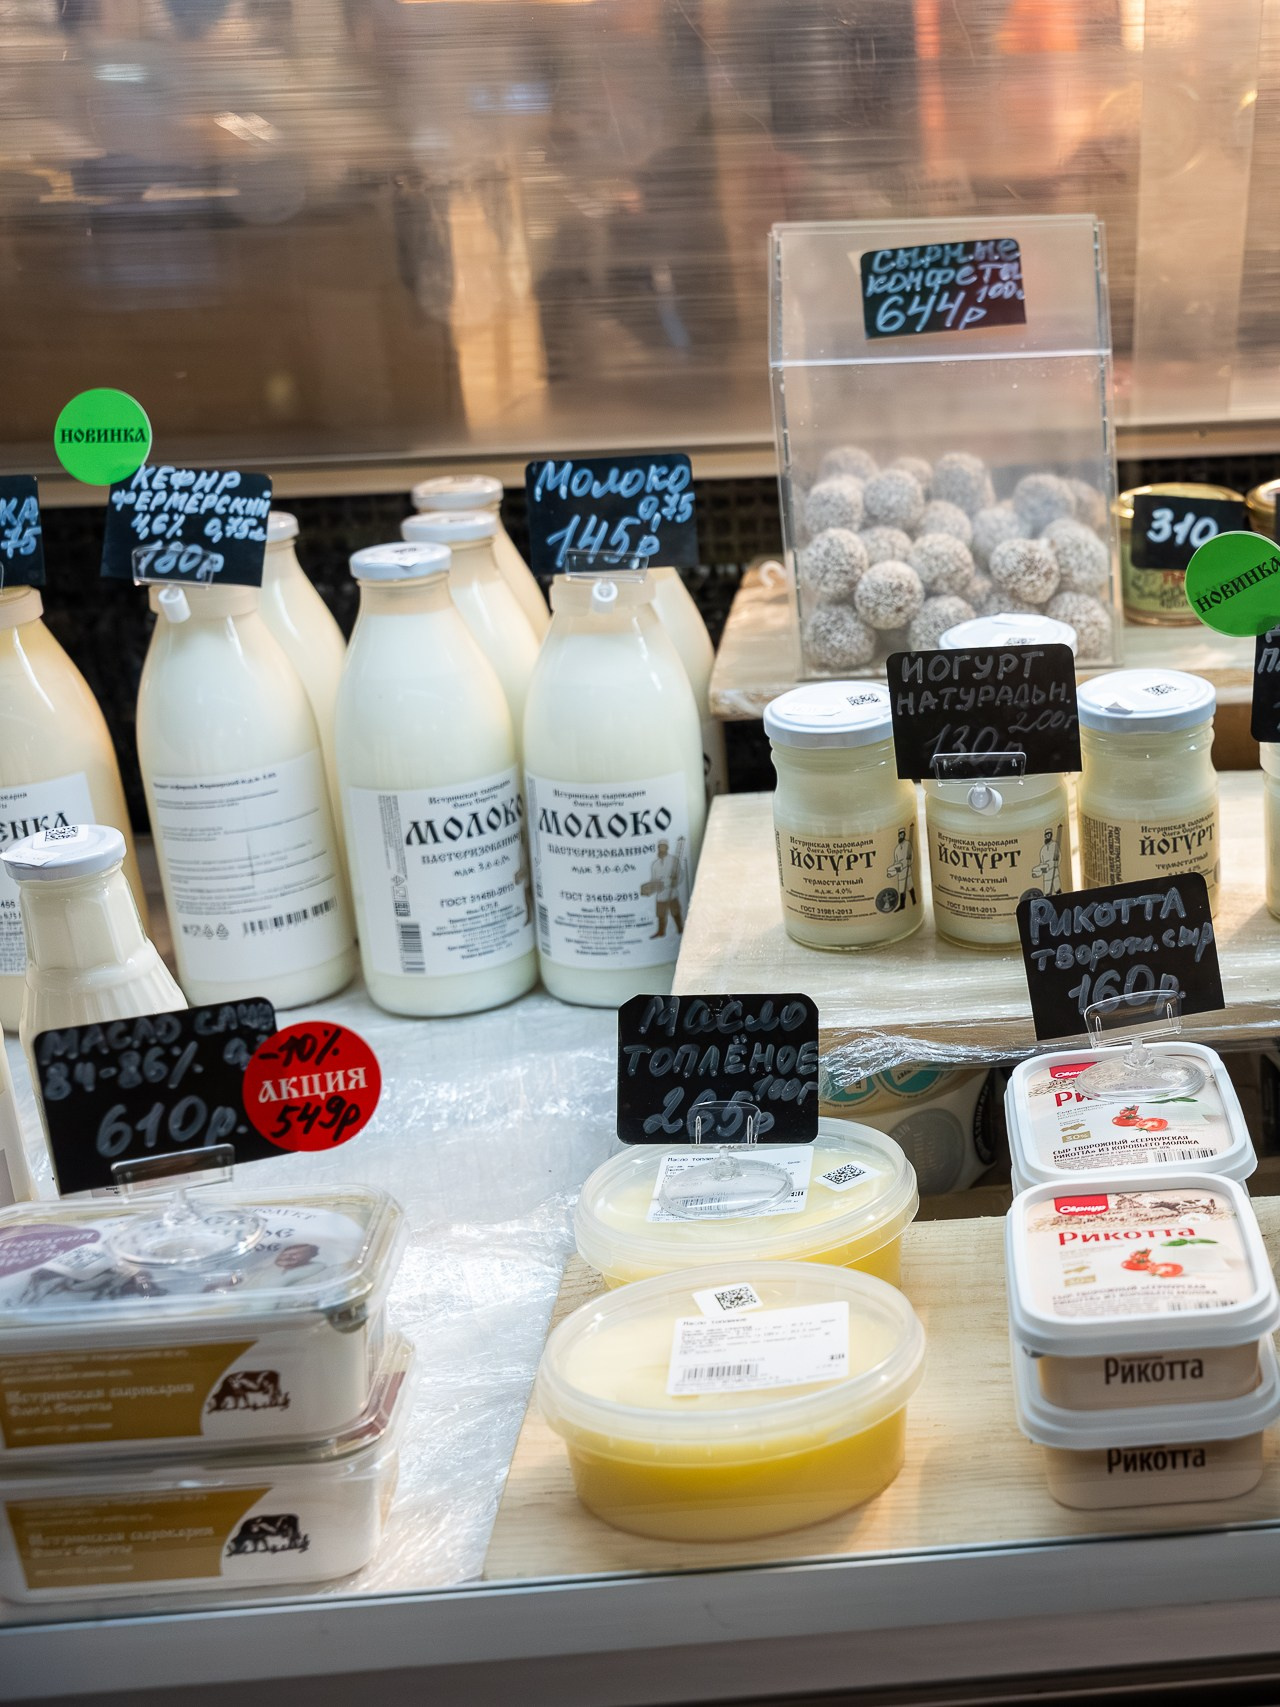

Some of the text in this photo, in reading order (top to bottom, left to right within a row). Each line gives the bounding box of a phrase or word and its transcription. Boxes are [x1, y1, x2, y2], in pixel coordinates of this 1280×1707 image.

[60, 428, 147, 444] НОВИНКА
[131, 465, 241, 495] КЕФИР
[112, 489, 272, 519] ФЕРМЕРСКИЙ
[1146, 508, 1220, 548] 310
[902, 651, 1045, 683] ЙОГУРТ
[405, 794, 523, 846] МОЛОКО
[539, 807, 672, 839] МОЛОКО
[548, 843, 656, 859] ПАСТЕРИЗОВАННОЕ
[790, 836, 874, 849] Истринская сыроварня
[938, 832, 1018, 847] Истринская сыроварня
[1139, 823, 1215, 856] ЙОГУРТ
[790, 847, 876, 876] ЙОГУРТ
[938, 843, 1021, 875] ЙОГУРТ
[803, 877, 864, 886] термостатный
[949, 873, 1008, 884] термостатный
[800, 904, 815, 913] ГОСТ
[947, 901, 961, 910] ГОСТ
[962, 904, 997, 913] 31981-2013
[41, 1013, 182, 1064] МАСЛО
[623, 1033, 818, 1077] ТОПЛЁНОЕ
[258, 1066, 368, 1104] АКЦИЯ
[270, 1096, 361, 1142] 549р
[1053, 1147, 1071, 1155] СЫР
[1075, 1138, 1128, 1152] ТВОРОЖНЫЙ
[1113, 1142, 1159, 1152] КОРОВЬЕГО
[1163, 1139, 1199, 1147] МОЛОКА
[1058, 1227, 1196, 1246] Рикотта
[1104, 1356, 1204, 1385] Рикотта
[1107, 1447, 1206, 1474] Рикотта
